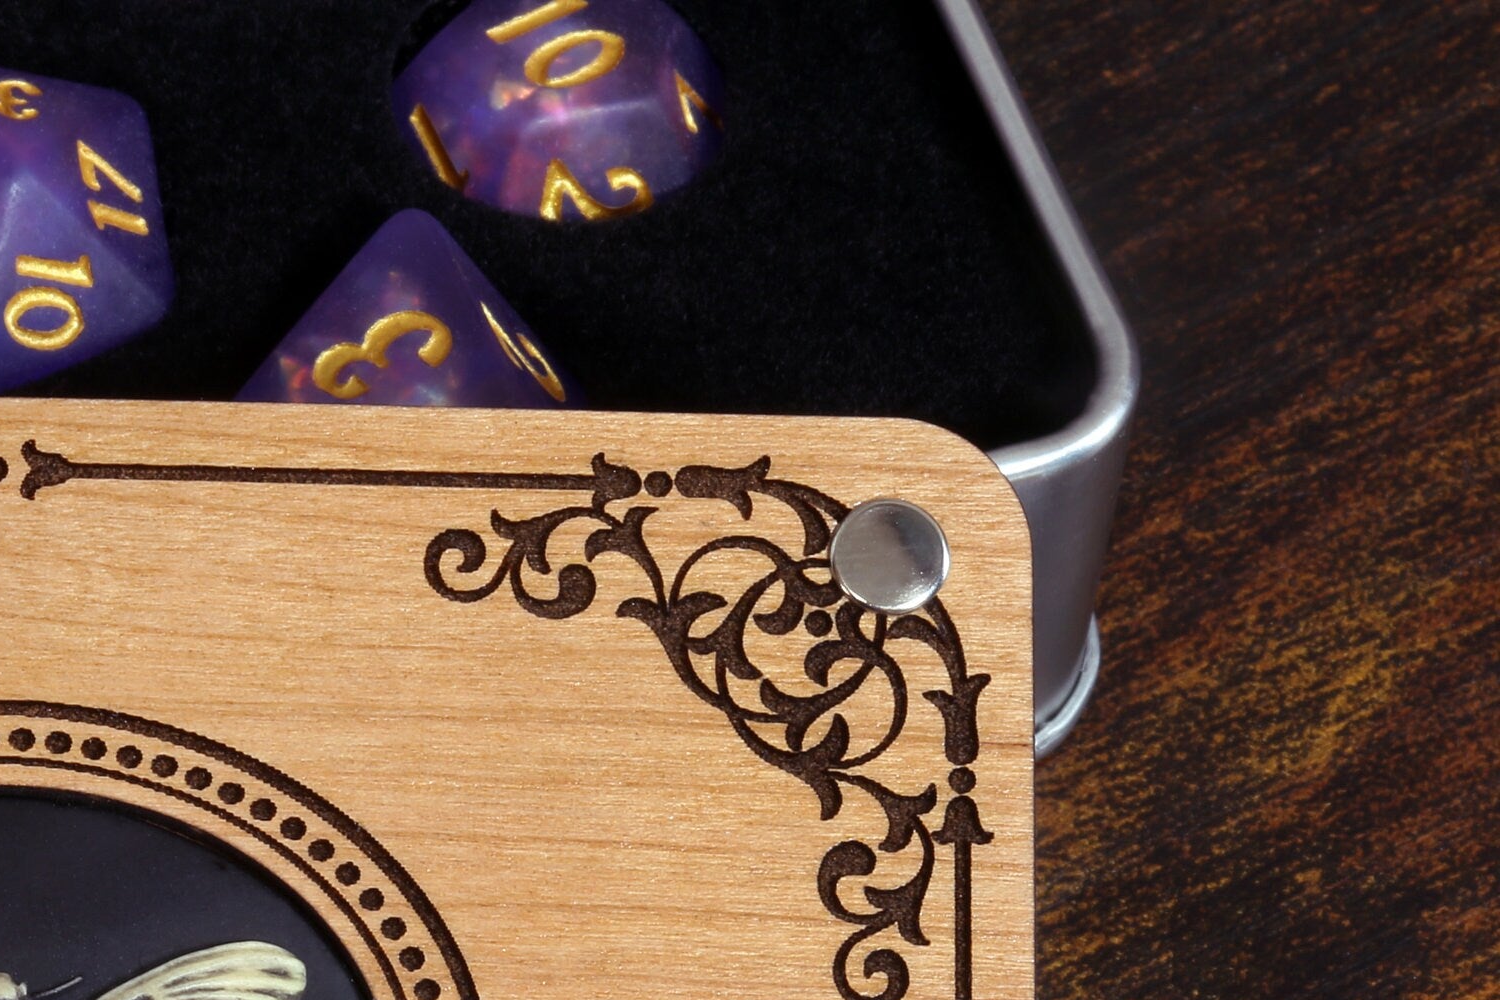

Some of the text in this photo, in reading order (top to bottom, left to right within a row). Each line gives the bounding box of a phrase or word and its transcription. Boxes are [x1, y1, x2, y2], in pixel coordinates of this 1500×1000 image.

[486, 0, 625, 88] 10
[76, 139, 149, 236] 17
[540, 158, 654, 221] 2
[4, 255, 94, 351] 10
[312, 311, 452, 398] 3
